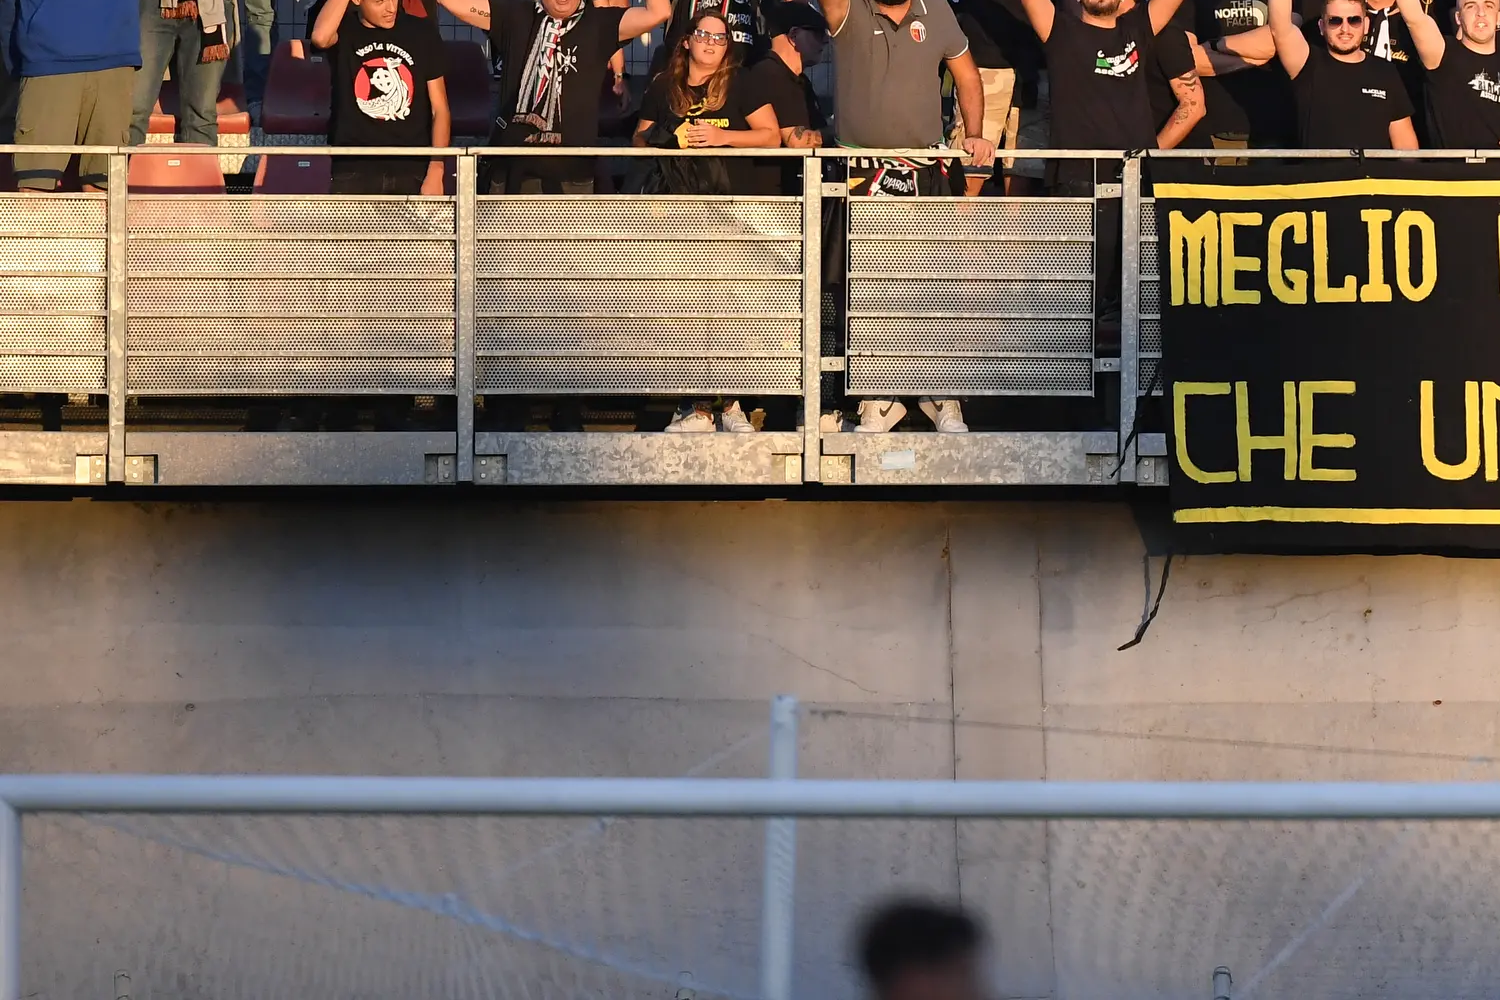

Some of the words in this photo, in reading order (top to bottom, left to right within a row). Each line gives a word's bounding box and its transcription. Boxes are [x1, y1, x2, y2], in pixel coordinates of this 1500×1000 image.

[1230, 0, 1251, 8] THE
[1214, 7, 1253, 19] NORTH
[1226, 18, 1251, 27] FACE
[386, 43, 414, 66] VITTORIA
[1169, 209, 1438, 308] MEGLIO
[1173, 380, 1357, 484] CHE
